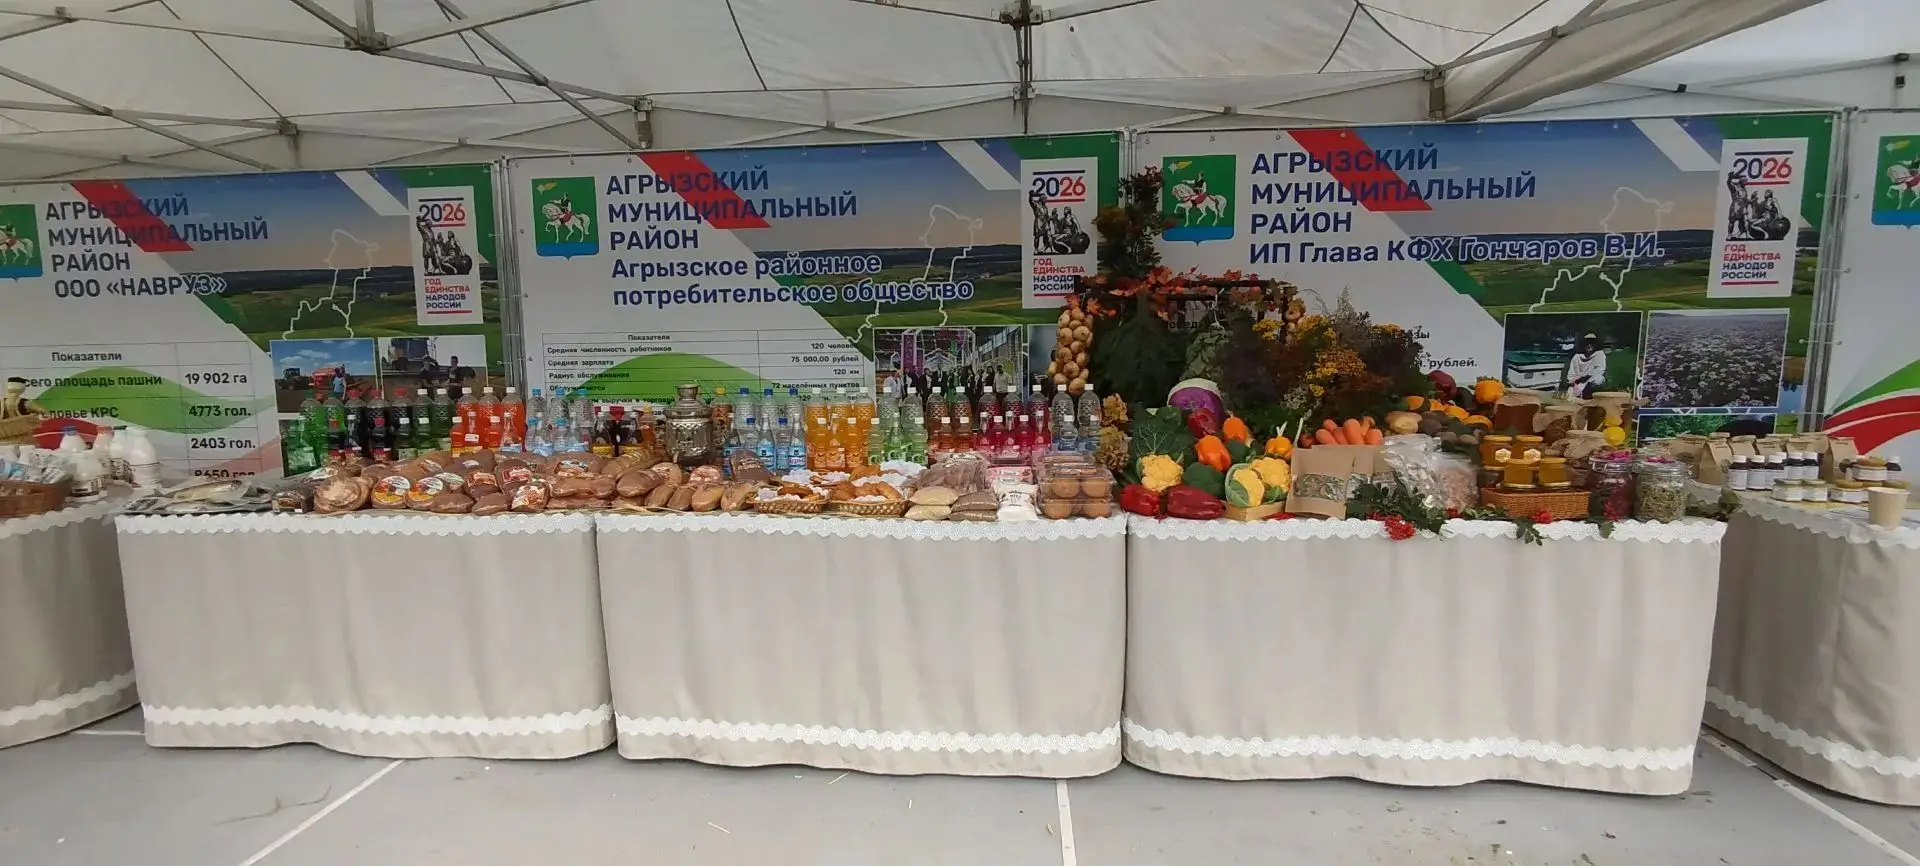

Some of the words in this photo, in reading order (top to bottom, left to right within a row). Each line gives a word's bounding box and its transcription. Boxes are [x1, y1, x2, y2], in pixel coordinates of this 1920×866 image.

[1251, 143, 1438, 174] АГРЫЗСКИЙ
[1733, 157, 1792, 180] 2026
[606, 165, 769, 195] АГРЫЗСКИЙ
[1032, 176, 1086, 197] 2026
[1252, 170, 1536, 206] МУНИЦИПАЛЬНЫЙ
[45, 192, 189, 221] АГРЫЗСКИЙ
[419, 203, 465, 222] 2026
[608, 190, 857, 224] МУНИЦИПАЛЬНЫЙ
[1251, 207, 1352, 234] РАЙОН
[48, 216, 268, 247] МУНИЦИПАЛЬНЫЙ
[610, 225, 699, 250] РАЙОН
[1250, 242, 1291, 264] ИП
[1300, 242, 1379, 263] Глава
[1388, 236, 1453, 262] КФХ
[1459, 236, 1598, 264] Гончаров
[1605, 232, 1665, 258] В.И.
[1724, 244, 1746, 252] ГОД
[51, 249, 130, 272] РАЙОН
[1033, 258, 1053, 266] ГОД
[1723, 252, 1781, 262] ЕДИНСТВА
[612, 258, 748, 282] Агрызское
[755, 252, 882, 279] районное
[1033, 266, 1085, 275] ЕДИНСТВА
[1723, 262, 1774, 270] НАРОДОВ
[1033, 275, 1074, 283] НАРОДО
[1721, 271, 1767, 279] РОССИИ
[54, 279, 100, 298] ООО
[106, 275, 227, 296] «НАВРУЗ»
[424, 278, 442, 286] ГОД
[1033, 283, 1074, 291] РОССИИ
[425, 286, 470, 294] ЕДИНСТВА
[613, 284, 837, 309] потребительское
[842, 278, 974, 304] общество
[425, 293, 467, 301] НАРОДОВ
[426, 301, 462, 309] РОССИИ
[629, 345, 672, 353] работников
[51, 351, 122, 362] Показатели
[832, 355, 859, 363] рублей
[1430, 358, 1477, 369] рублей.
[24, 378, 51, 388] сего
[55, 375, 115, 388] площадь
[118, 375, 163, 386] пашни
[185, 373, 199, 385] 19
[203, 372, 229, 385] 902
[233, 375, 247, 384] га
[549, 372, 574, 380] Радиус
[830, 382, 860, 390] пунктов
[91, 406, 119, 418] КРС
[189, 405, 221, 417] 4773
[225, 407, 251, 416] гол.
[191, 438, 226, 450] 2403
[229, 439, 256, 449] гол.
